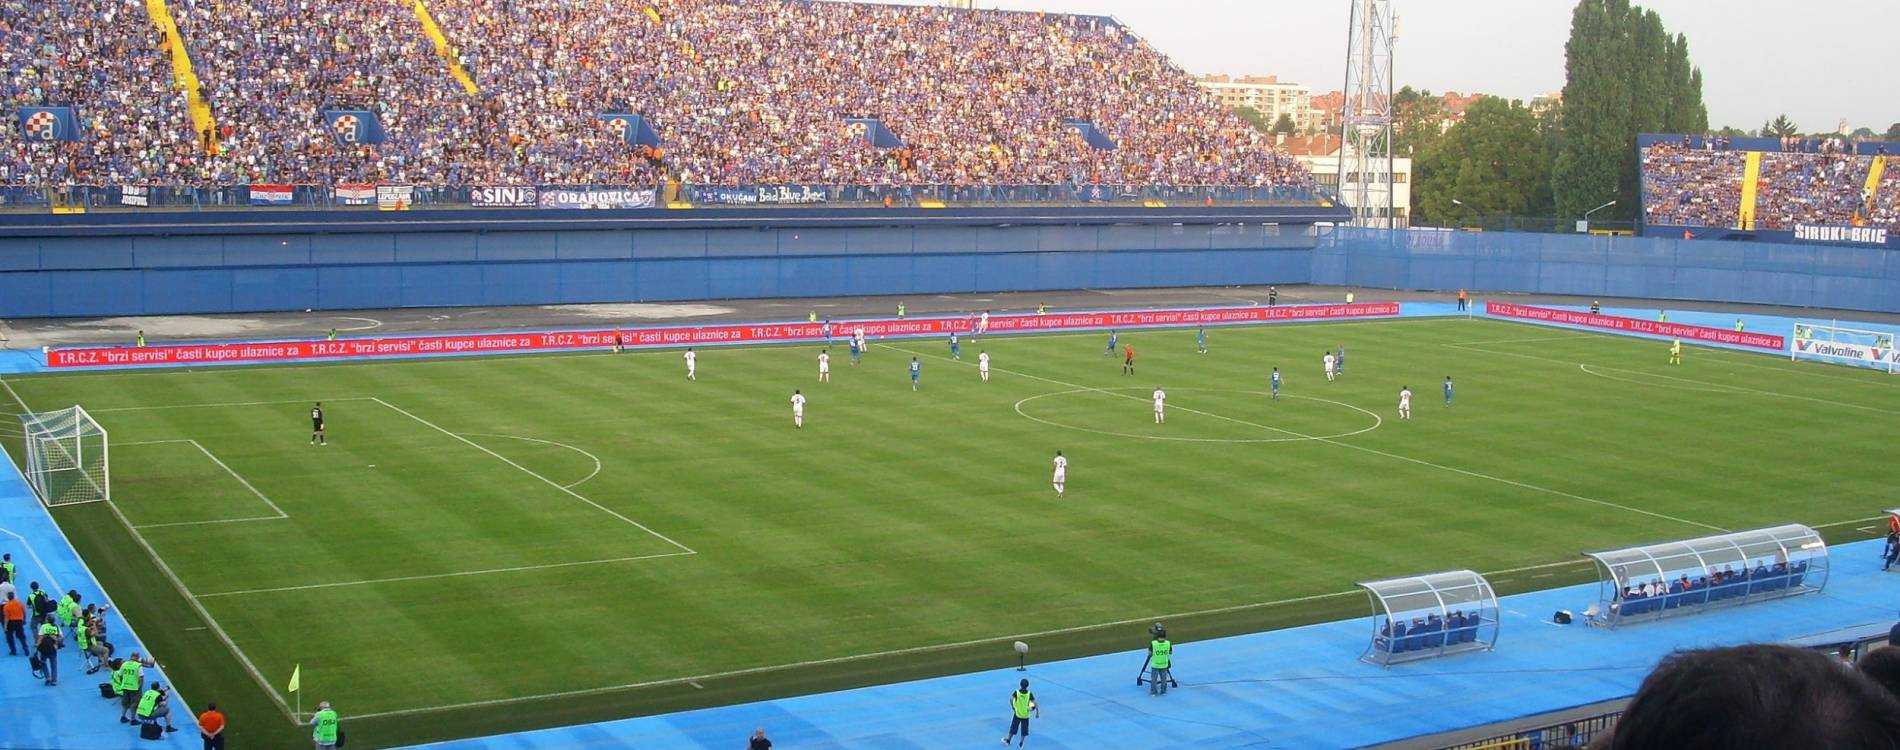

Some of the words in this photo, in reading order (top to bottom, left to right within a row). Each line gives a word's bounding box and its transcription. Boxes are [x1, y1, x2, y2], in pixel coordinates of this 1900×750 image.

[484, 189, 524, 203] SINJ
[759, 188, 778, 202] Bad
[779, 186, 800, 200] Blue
[862, 323, 885, 334] kupce
[887, 322, 922, 332] ulaznice
[418, 340, 442, 350] časti
[445, 340, 474, 350] kupce
[477, 337, 517, 348] ulaznice
[519, 338, 530, 346] za
[603, 332, 637, 343] serisi"
[640, 332, 662, 342] časti
[664, 330, 690, 342] kupce
[692, 330, 728, 340] ulaznice
[176, 350, 202, 360] časti
[205, 348, 237, 361] kupce
[241, 346, 284, 358] ulaznice
[287, 348, 298, 356] za
[1815, 344, 1864, 358] Valvoline
